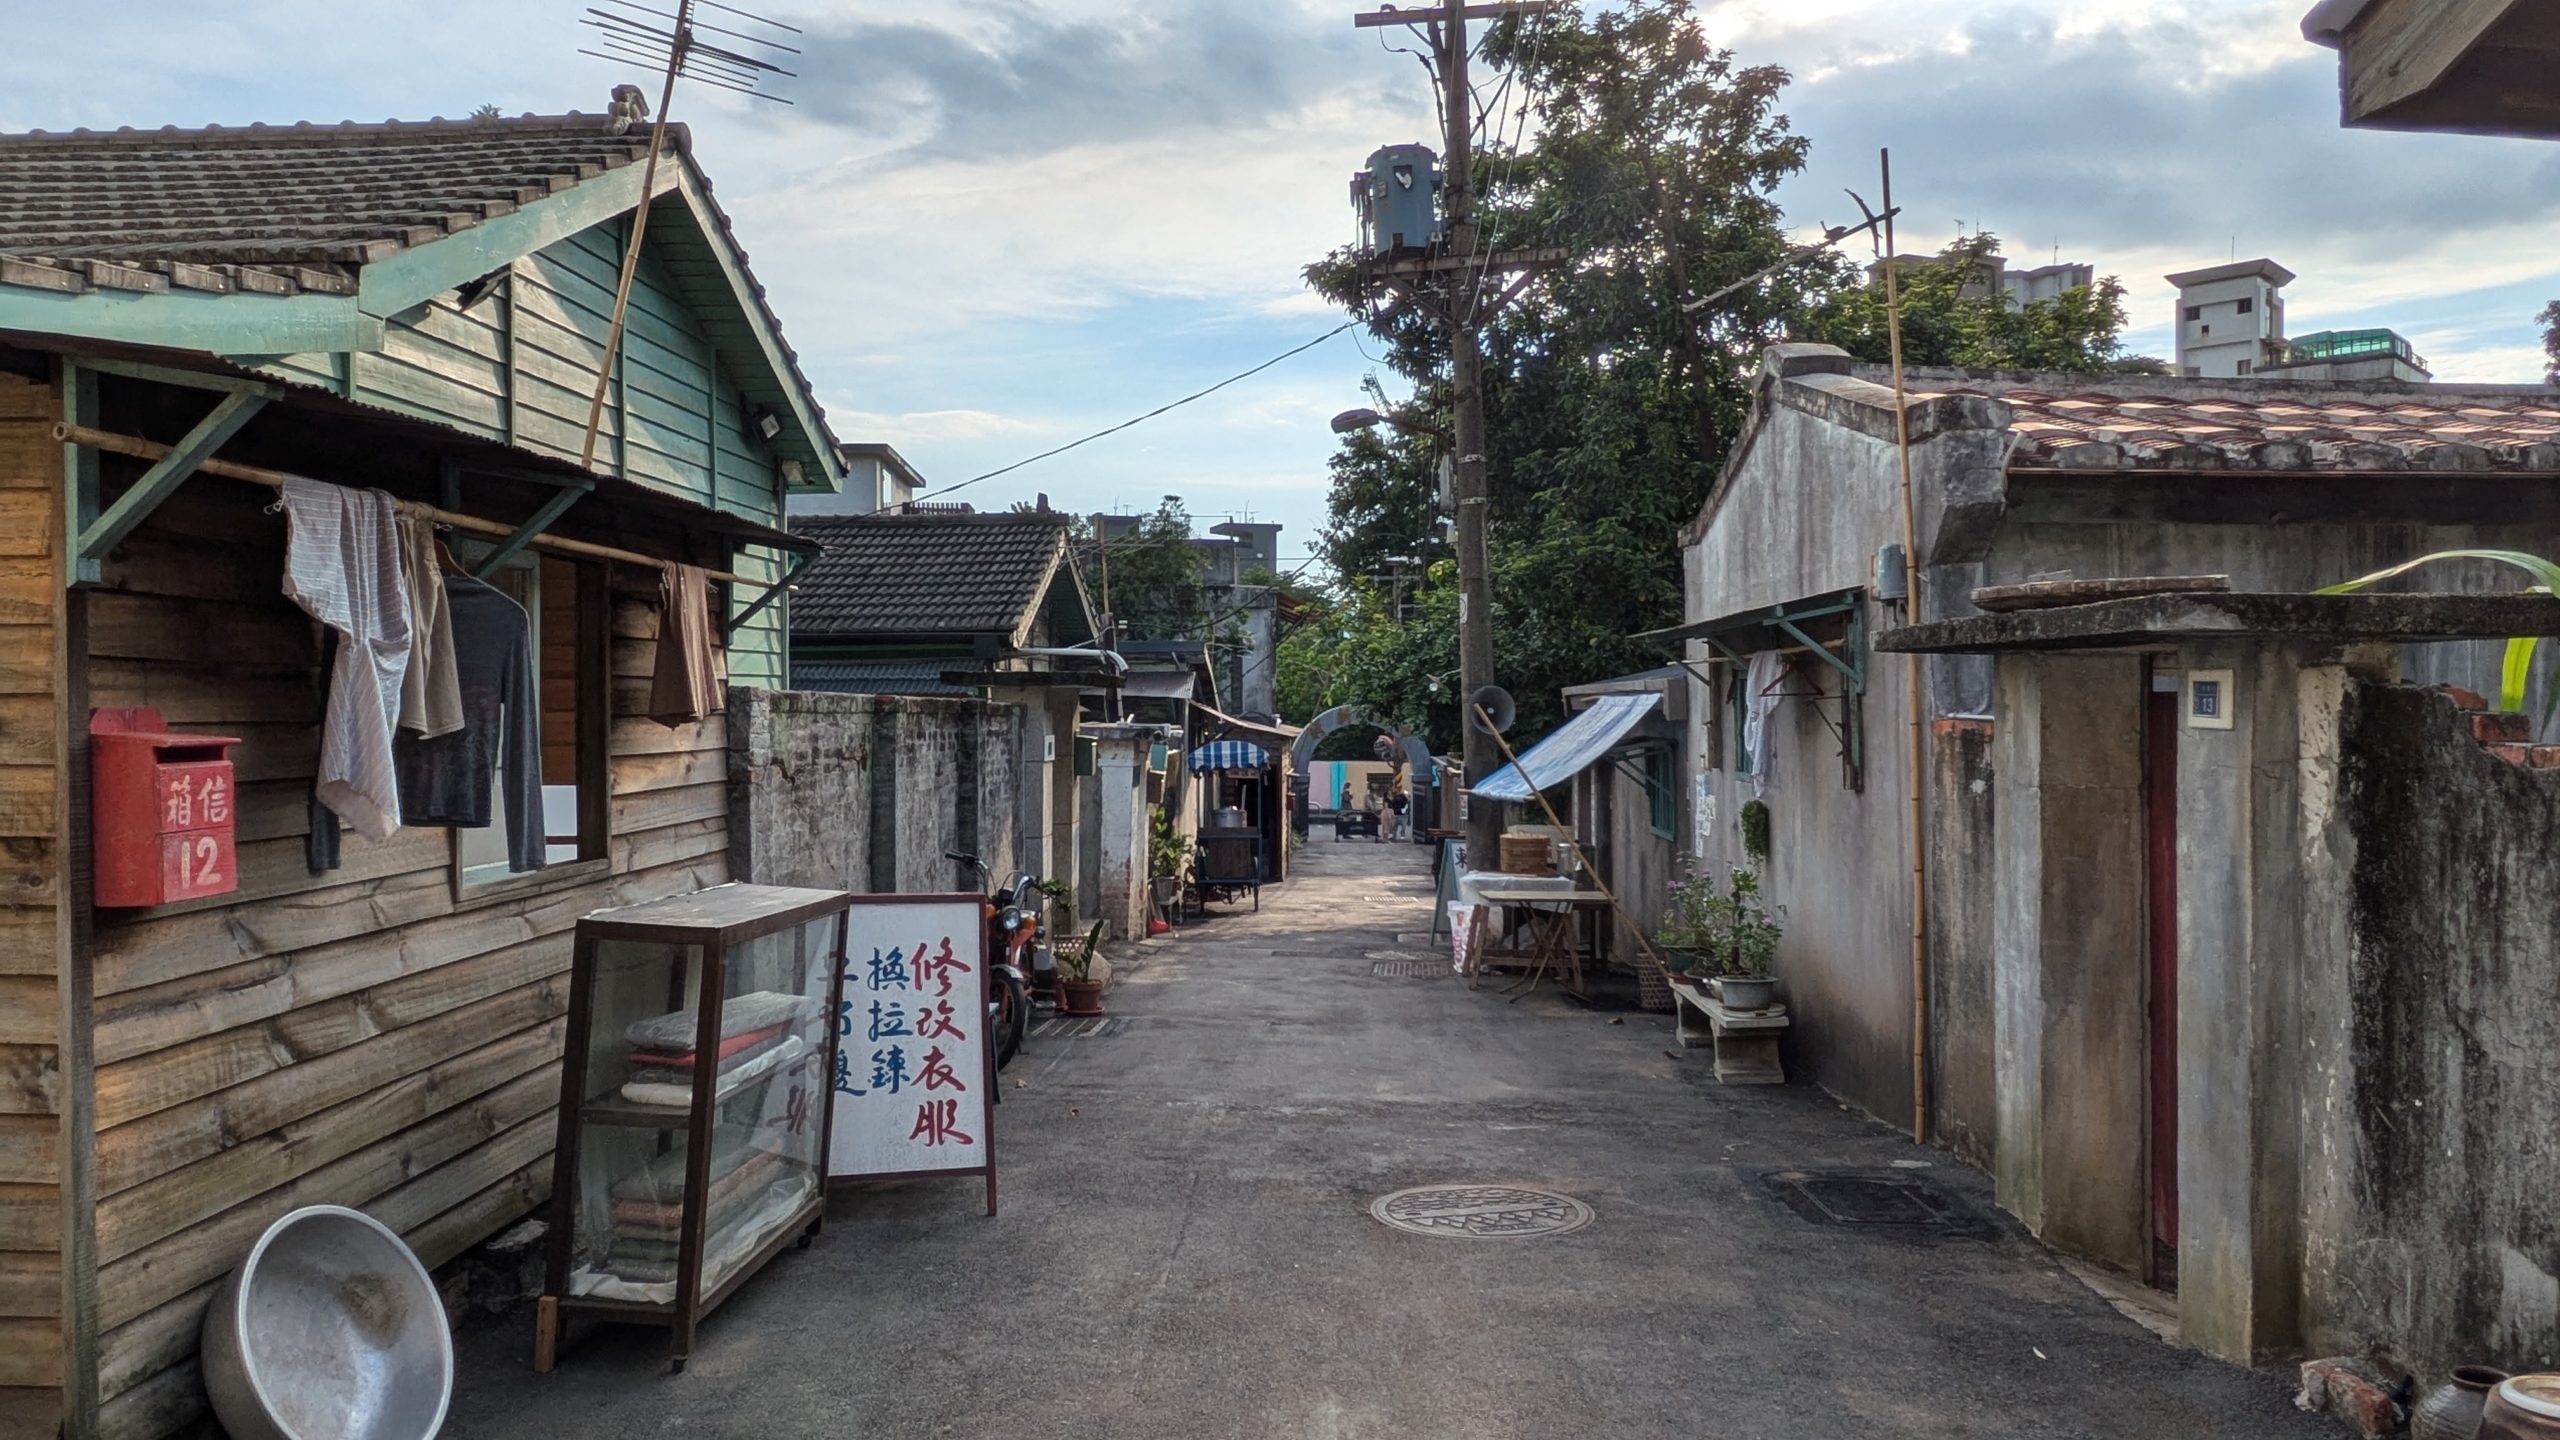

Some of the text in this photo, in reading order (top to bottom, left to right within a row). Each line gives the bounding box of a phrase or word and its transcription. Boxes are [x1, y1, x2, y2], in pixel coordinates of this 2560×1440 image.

[2202, 698, 2214, 713] 13
[181, 836, 222, 889] 12
[909, 936, 973, 1146] 修改衣服
